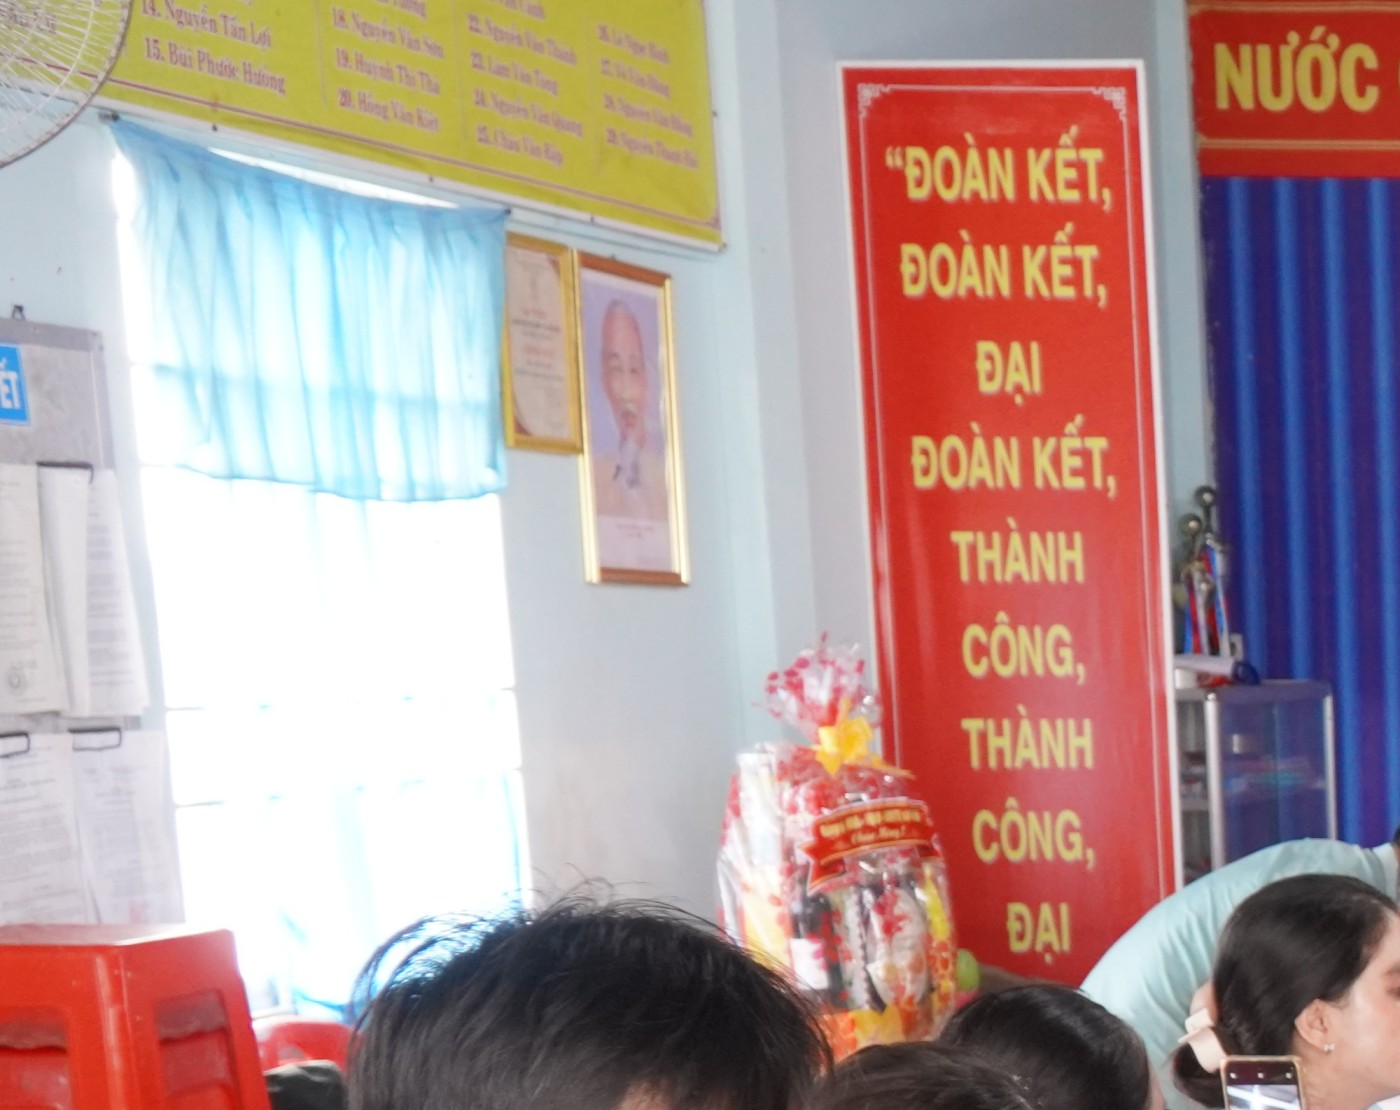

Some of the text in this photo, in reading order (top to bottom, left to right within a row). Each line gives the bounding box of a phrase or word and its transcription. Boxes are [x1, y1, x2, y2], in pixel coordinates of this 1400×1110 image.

[1216, 27, 1378, 112] NƯỚC
[885, 124, 1112, 211] “ĐOÀN KẾT,
[900, 222, 1107, 308] ĐOÀN KẾT,
[975, 340, 1042, 406] ĐẠI
[911, 413, 1117, 499] ĐOÀN KẾT,
[950, 516, 1085, 584] THÀNH
[962, 610, 1086, 684] CÔNG,
[961, 703, 1095, 771] THÀNH
[972, 796, 1096, 870] CÔNG,
[1007, 902, 1070, 966] ĐẠI
